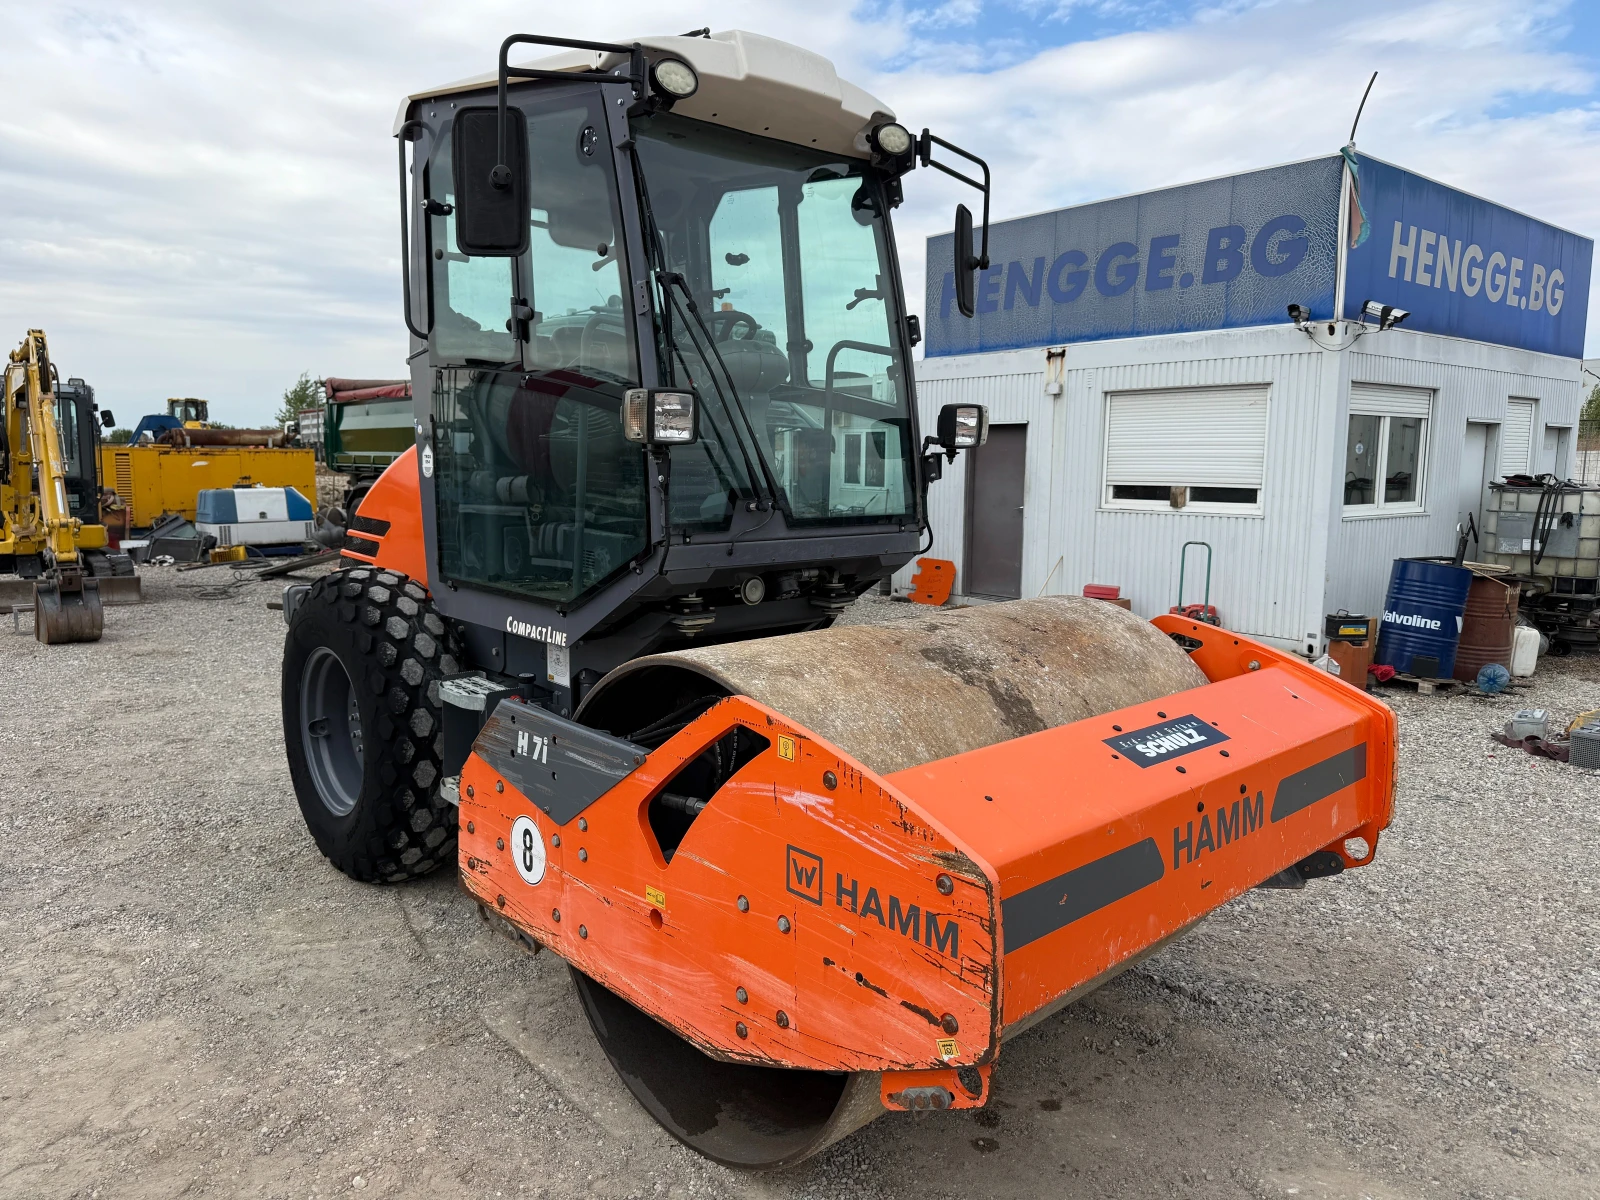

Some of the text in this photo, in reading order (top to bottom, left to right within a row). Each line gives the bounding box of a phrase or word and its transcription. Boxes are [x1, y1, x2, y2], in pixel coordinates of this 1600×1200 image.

[1388, 220, 1565, 316] HENGGE.BG
[517, 730, 548, 764] H 7i
[1136, 728, 1208, 757] SCHULZ
[523, 828, 533, 872] 8
[1173, 791, 1264, 870] HAMM
[836, 872, 959, 959] HAMM
